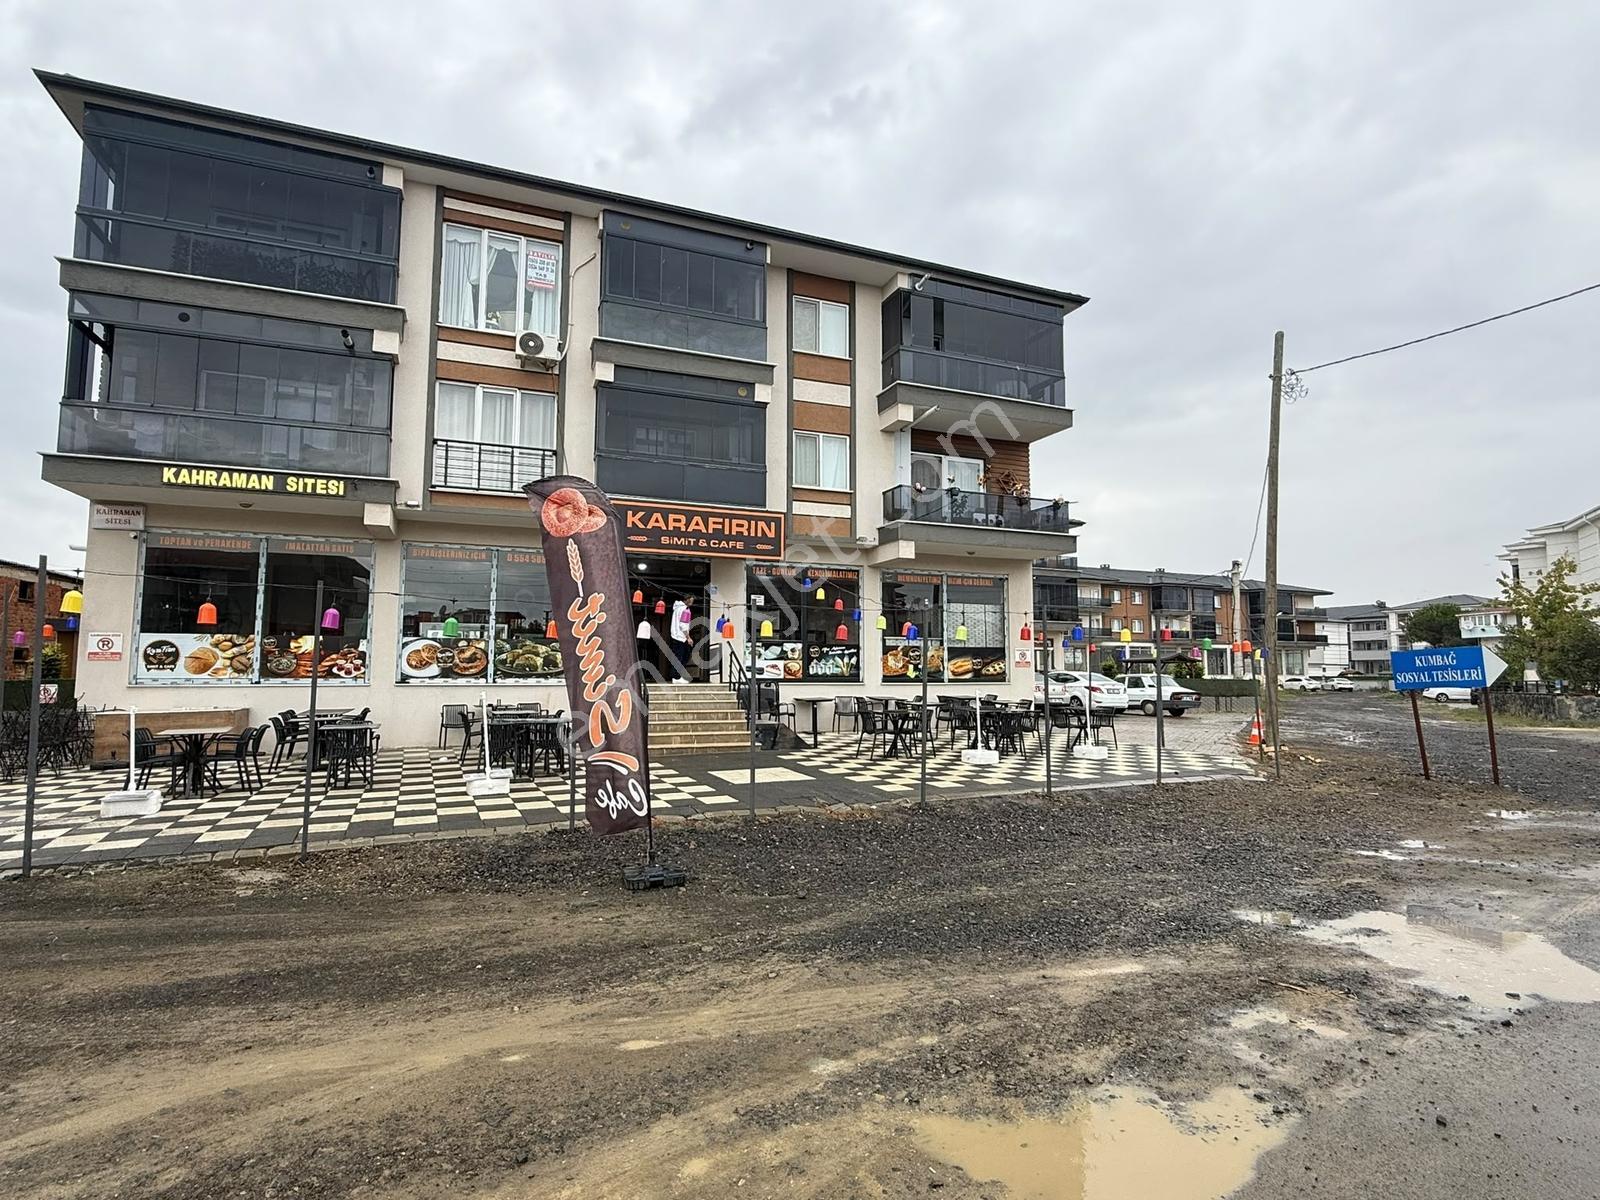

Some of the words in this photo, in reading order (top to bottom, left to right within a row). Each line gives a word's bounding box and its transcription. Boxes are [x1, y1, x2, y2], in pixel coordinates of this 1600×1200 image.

[162, 467, 274, 490] KAHRAMAN
[96, 508, 141, 516] KAHRAMAN
[626, 510, 775, 538] KARAFIRIN
[160, 536, 191, 546] TOPTAN
[205, 539, 252, 549] PERAKENDE
[698, 539, 708, 547] &
[710, 540, 744, 549] CAFE
[1415, 651, 1457, 667] KUMBAĞ
[1396, 671, 1432, 683] SOSYAL
[1431, 666, 1483, 681] TESİSLERİ
